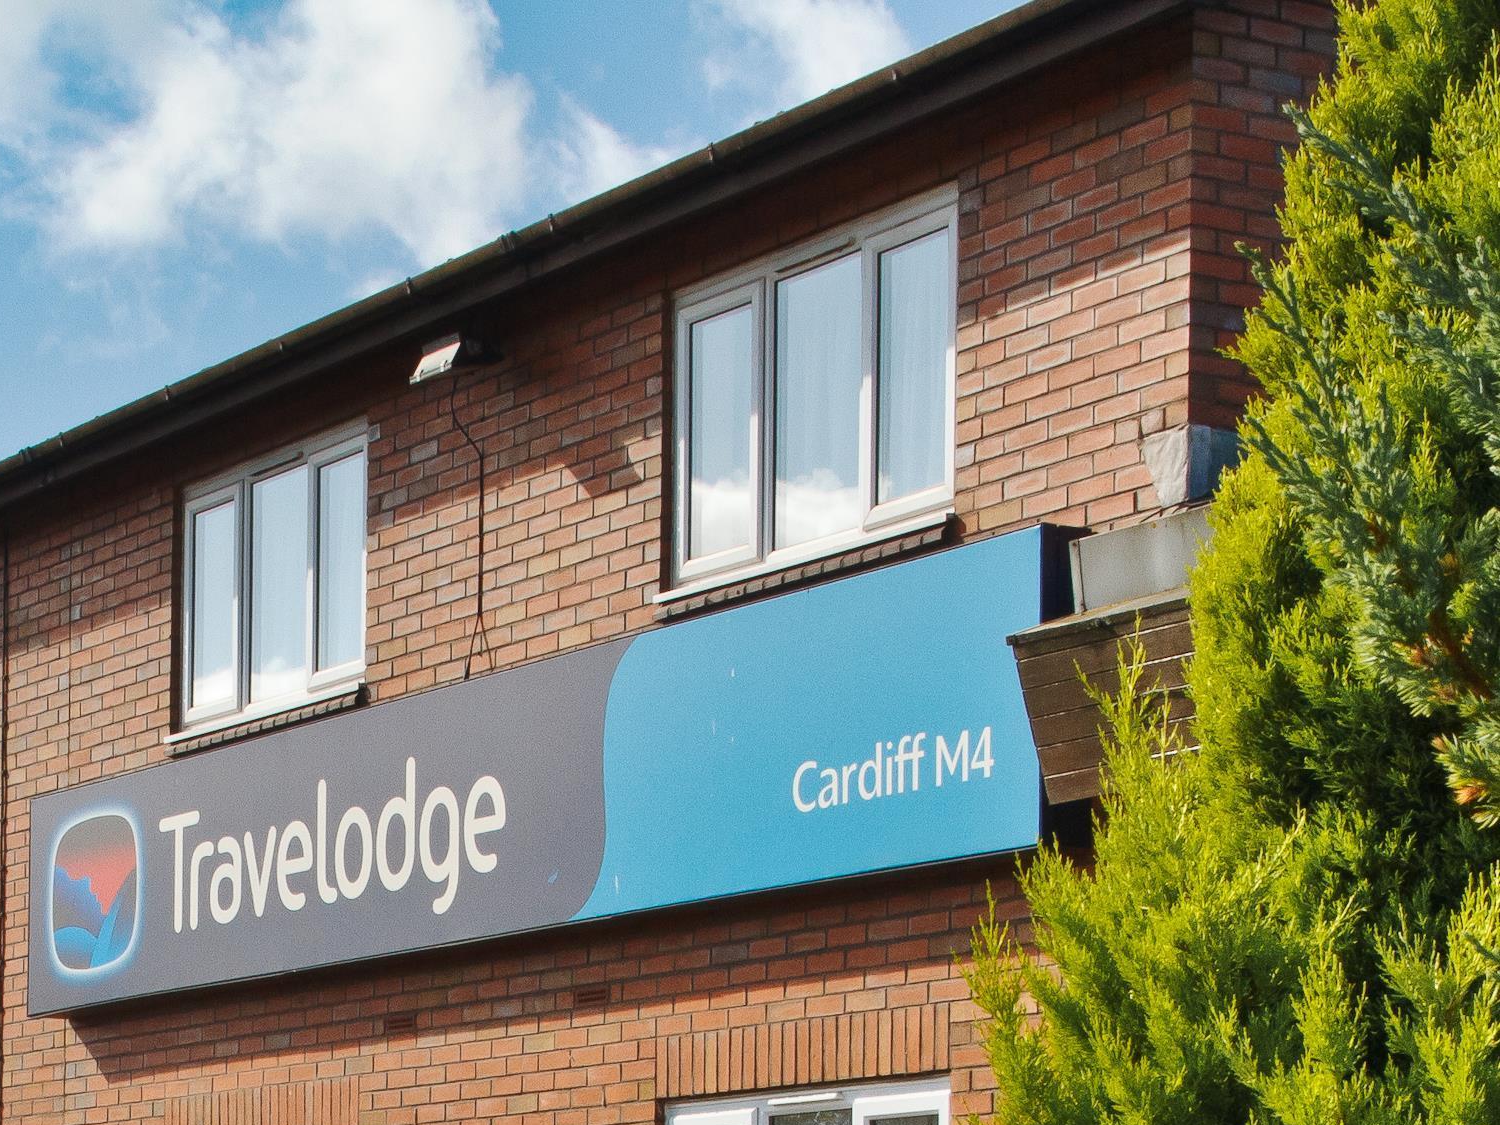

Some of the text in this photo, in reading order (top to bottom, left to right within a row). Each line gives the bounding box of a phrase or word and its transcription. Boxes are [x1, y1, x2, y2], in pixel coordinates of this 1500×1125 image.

[792, 726, 995, 813] Cardiff M4
[158, 756, 507, 934] Travelodge
